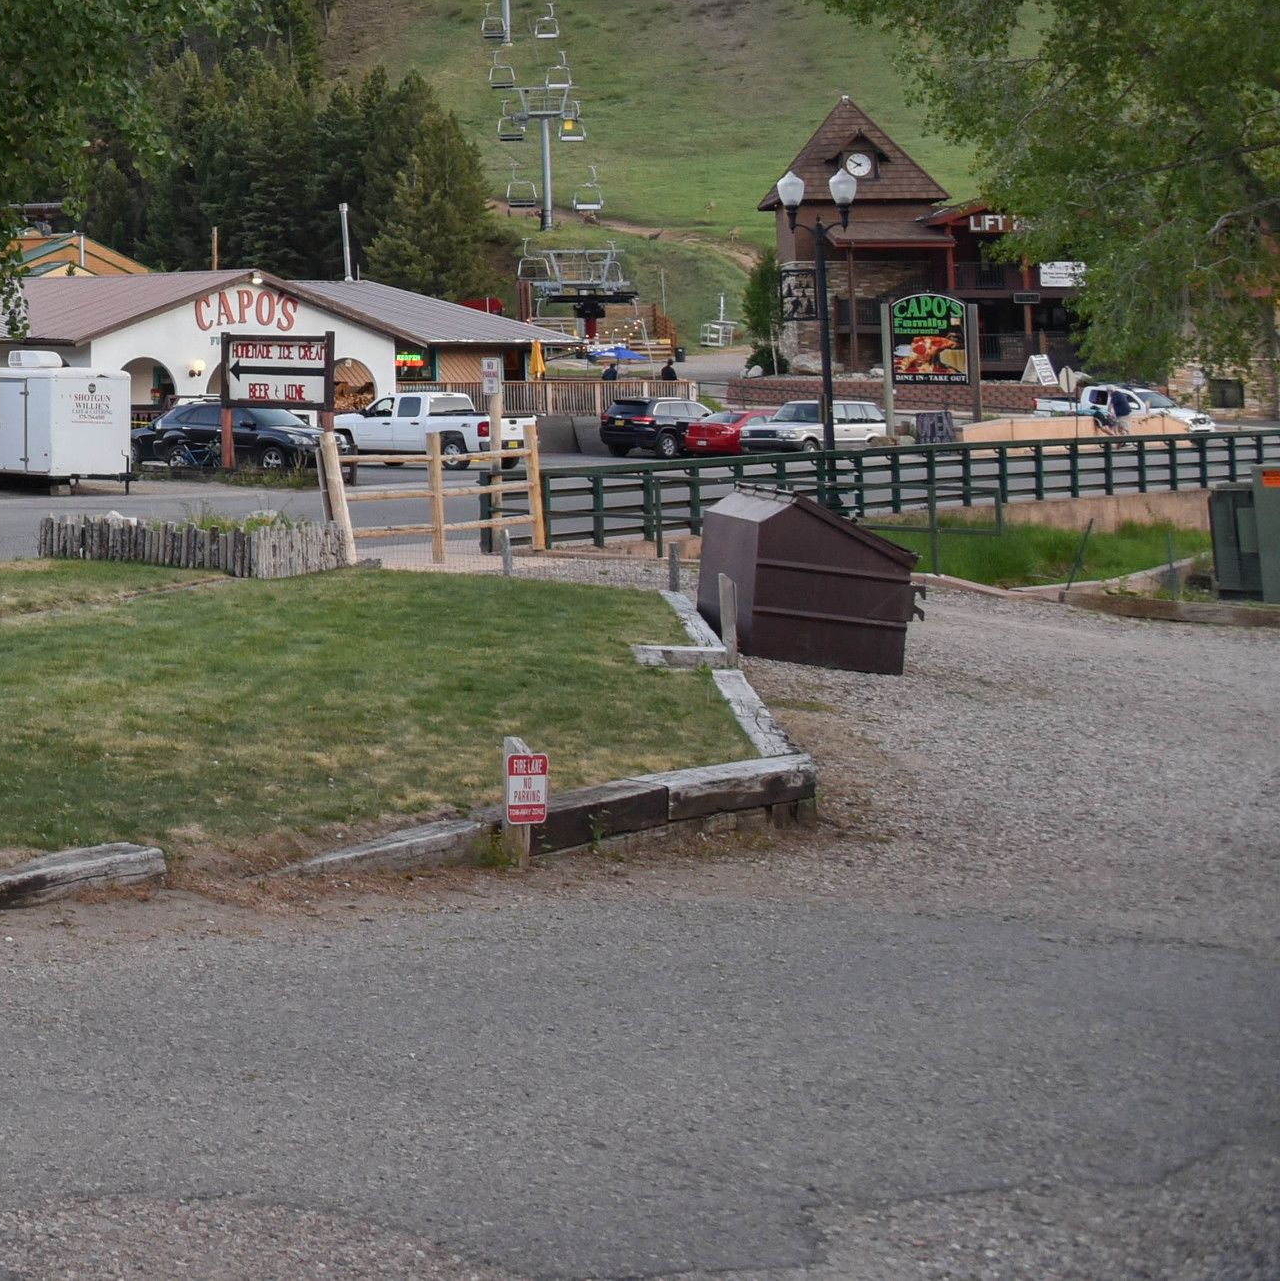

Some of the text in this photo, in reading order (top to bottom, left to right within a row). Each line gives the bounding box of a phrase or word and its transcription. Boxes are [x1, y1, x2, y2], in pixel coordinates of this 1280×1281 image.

[970, 214, 1007, 232] LIFT
[194, 289, 299, 332] CAPO'S
[893, 295, 964, 318] CAPO'S
[893, 317, 948, 330] Family
[231, 342, 273, 360] HOMEMADE
[277, 343, 295, 360] ICE
[895, 374, 967, 382] DINE IN TAKE OUT
[73, 393, 111, 402] SHOTGUN
[248, 382, 270, 400] BEER
[75, 402, 110, 410] WILLIE'S
[513, 758, 543, 774] FIRE LANE
[523, 777, 532, 789] NO
[514, 790, 541, 802] PARKING
